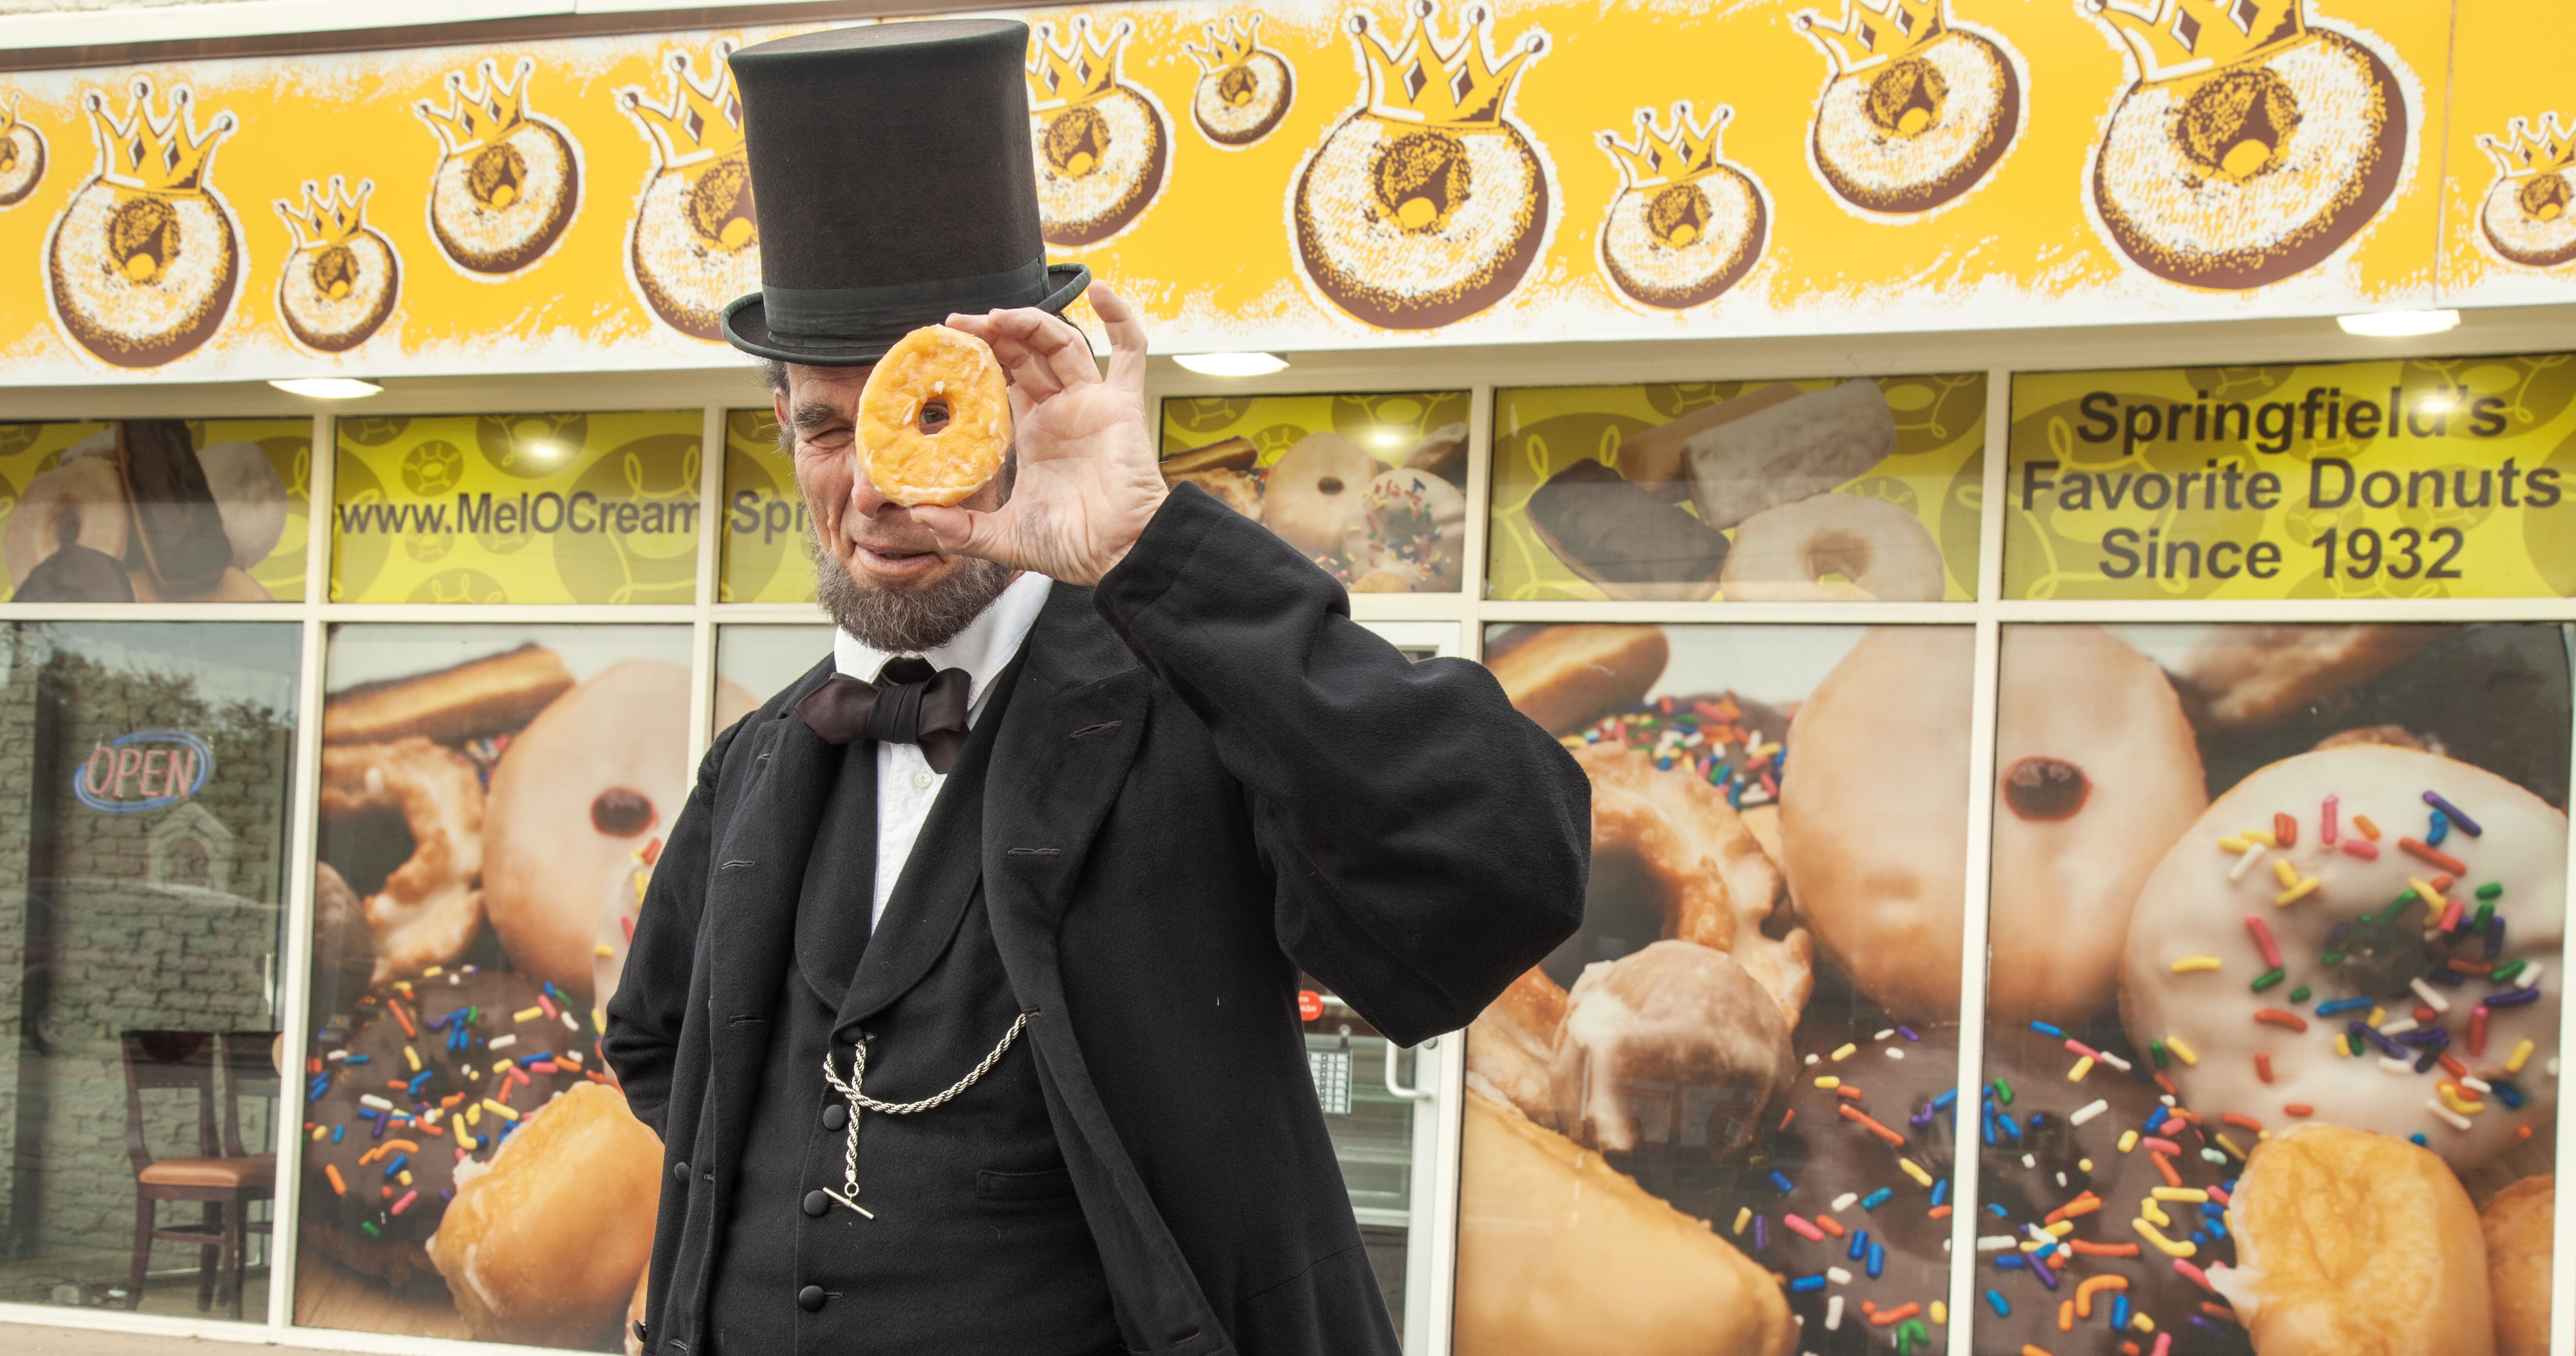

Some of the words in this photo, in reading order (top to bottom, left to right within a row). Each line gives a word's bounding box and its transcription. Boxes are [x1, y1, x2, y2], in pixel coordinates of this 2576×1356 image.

[2077, 386, 2507, 455] Springfield's
[2021, 459, 2281, 511] Favorite
[2308, 456, 2562, 510] Donuts
[2098, 527, 2282, 580] Since
[2311, 527, 2465, 579] 1932
[86, 746, 195, 798] OPEN
